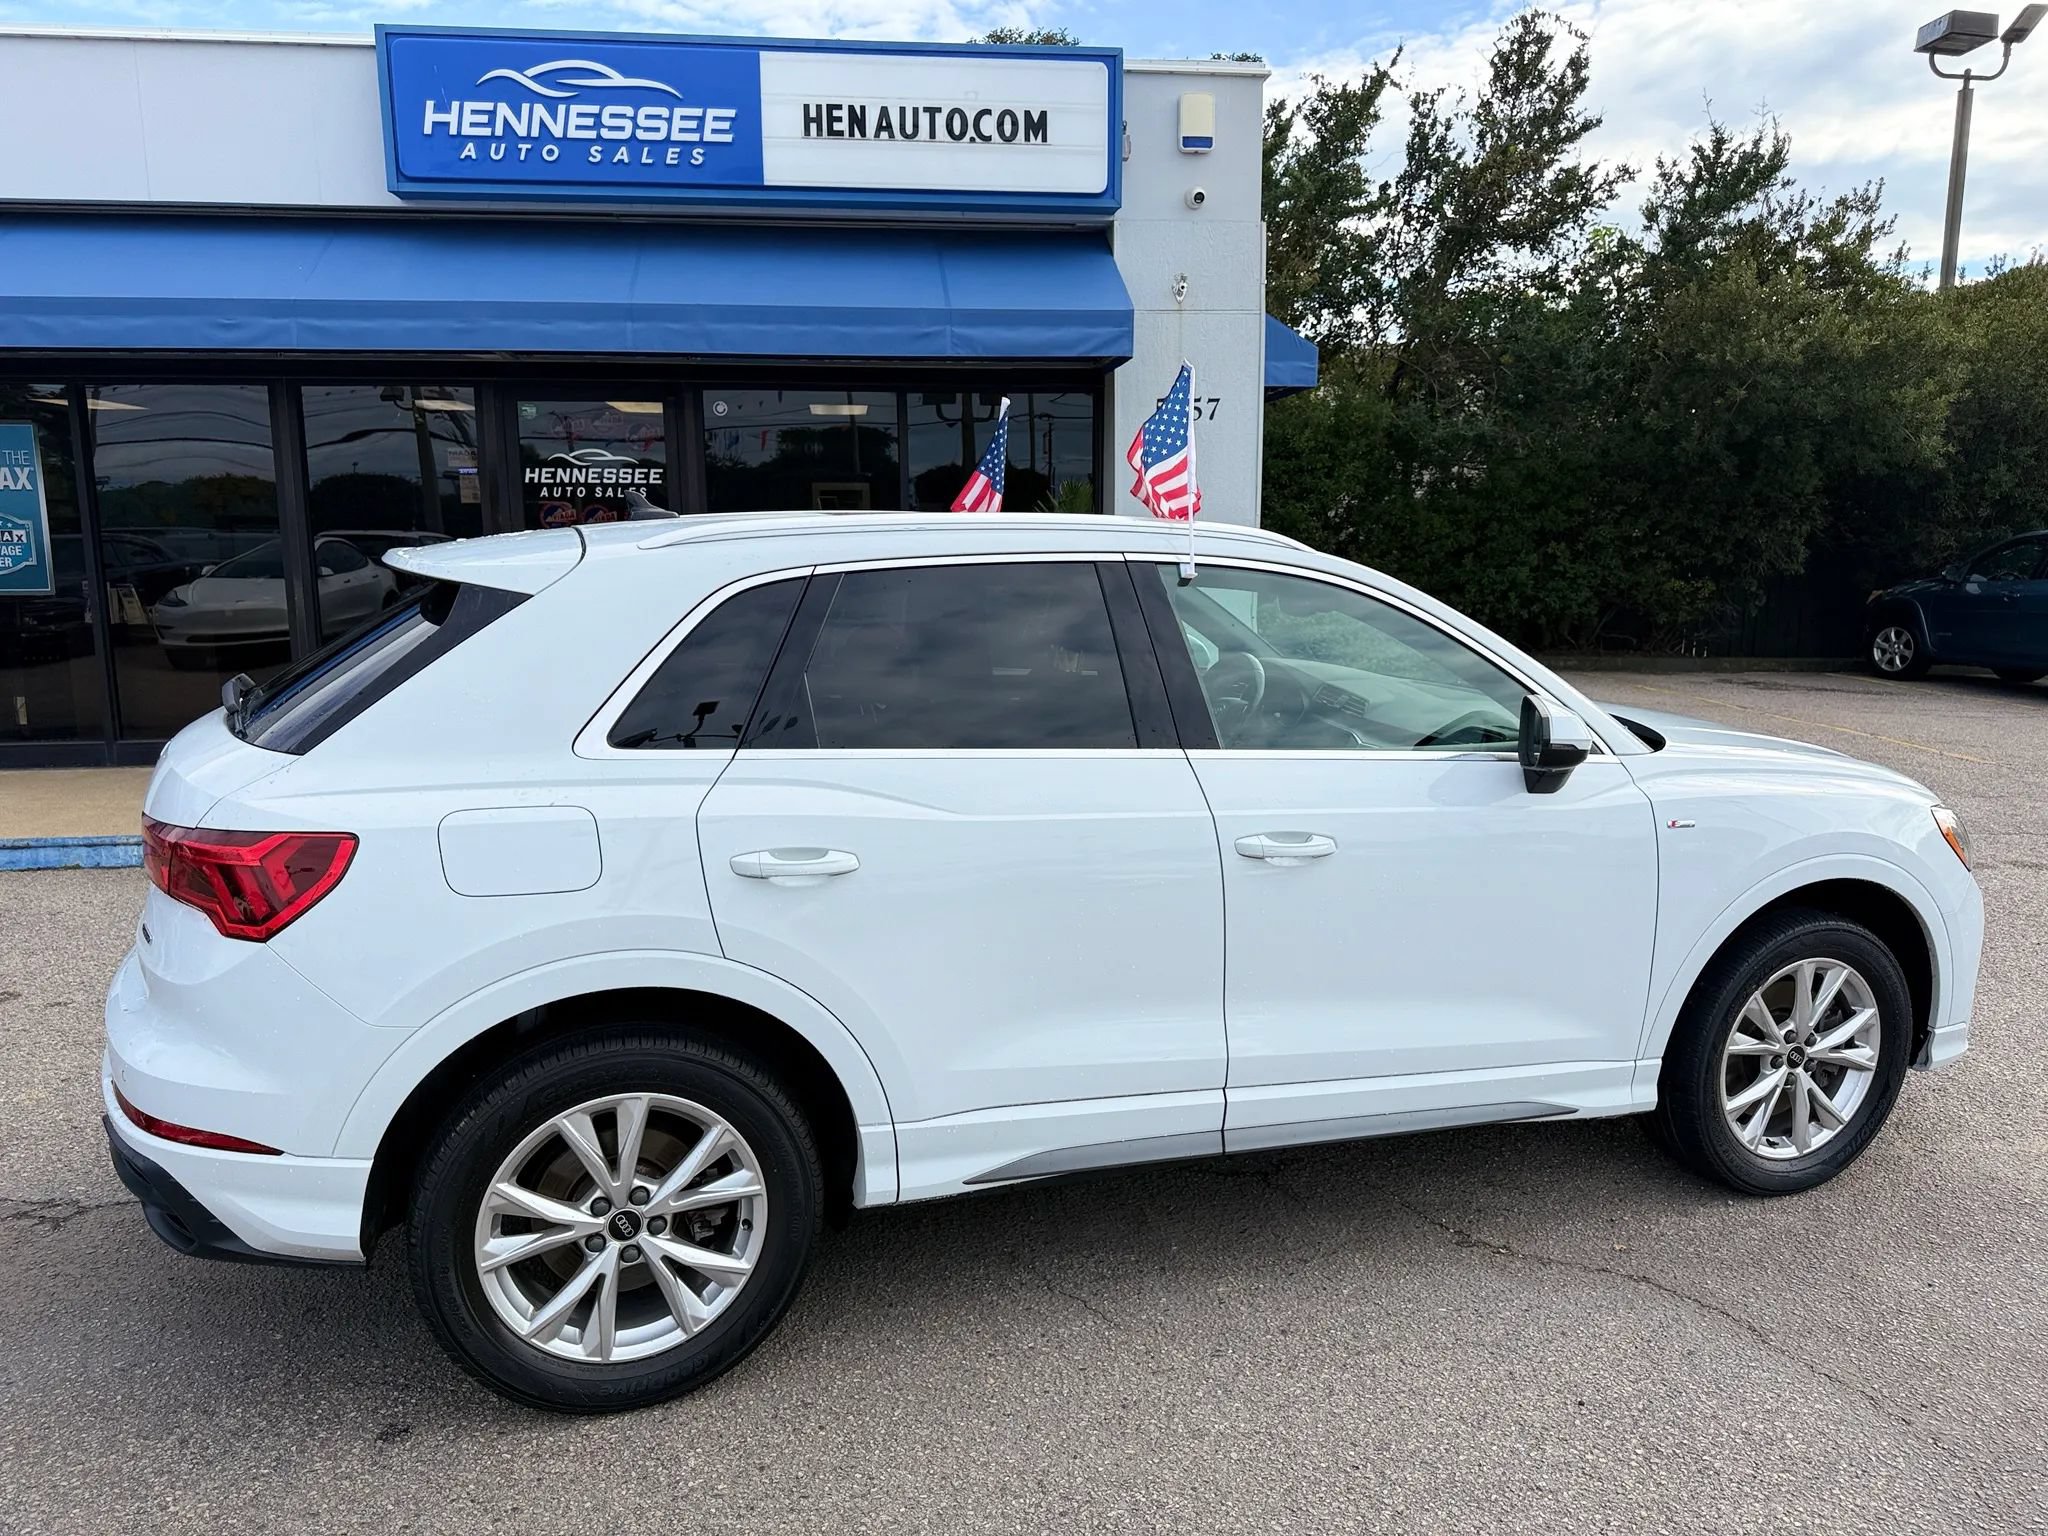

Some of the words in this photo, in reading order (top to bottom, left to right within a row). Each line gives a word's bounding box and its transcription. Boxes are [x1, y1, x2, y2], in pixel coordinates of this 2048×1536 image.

[423, 100, 737, 143] HENNESSEE
[802, 103, 1048, 143] HENAUTO.COM
[459, 142, 560, 162] AUTO
[588, 145, 705, 165] SALES
[2, 450, 31, 465] THE
[524, 467, 664, 484] HENNESSEE
[540, 486, 587, 498] AUTO
